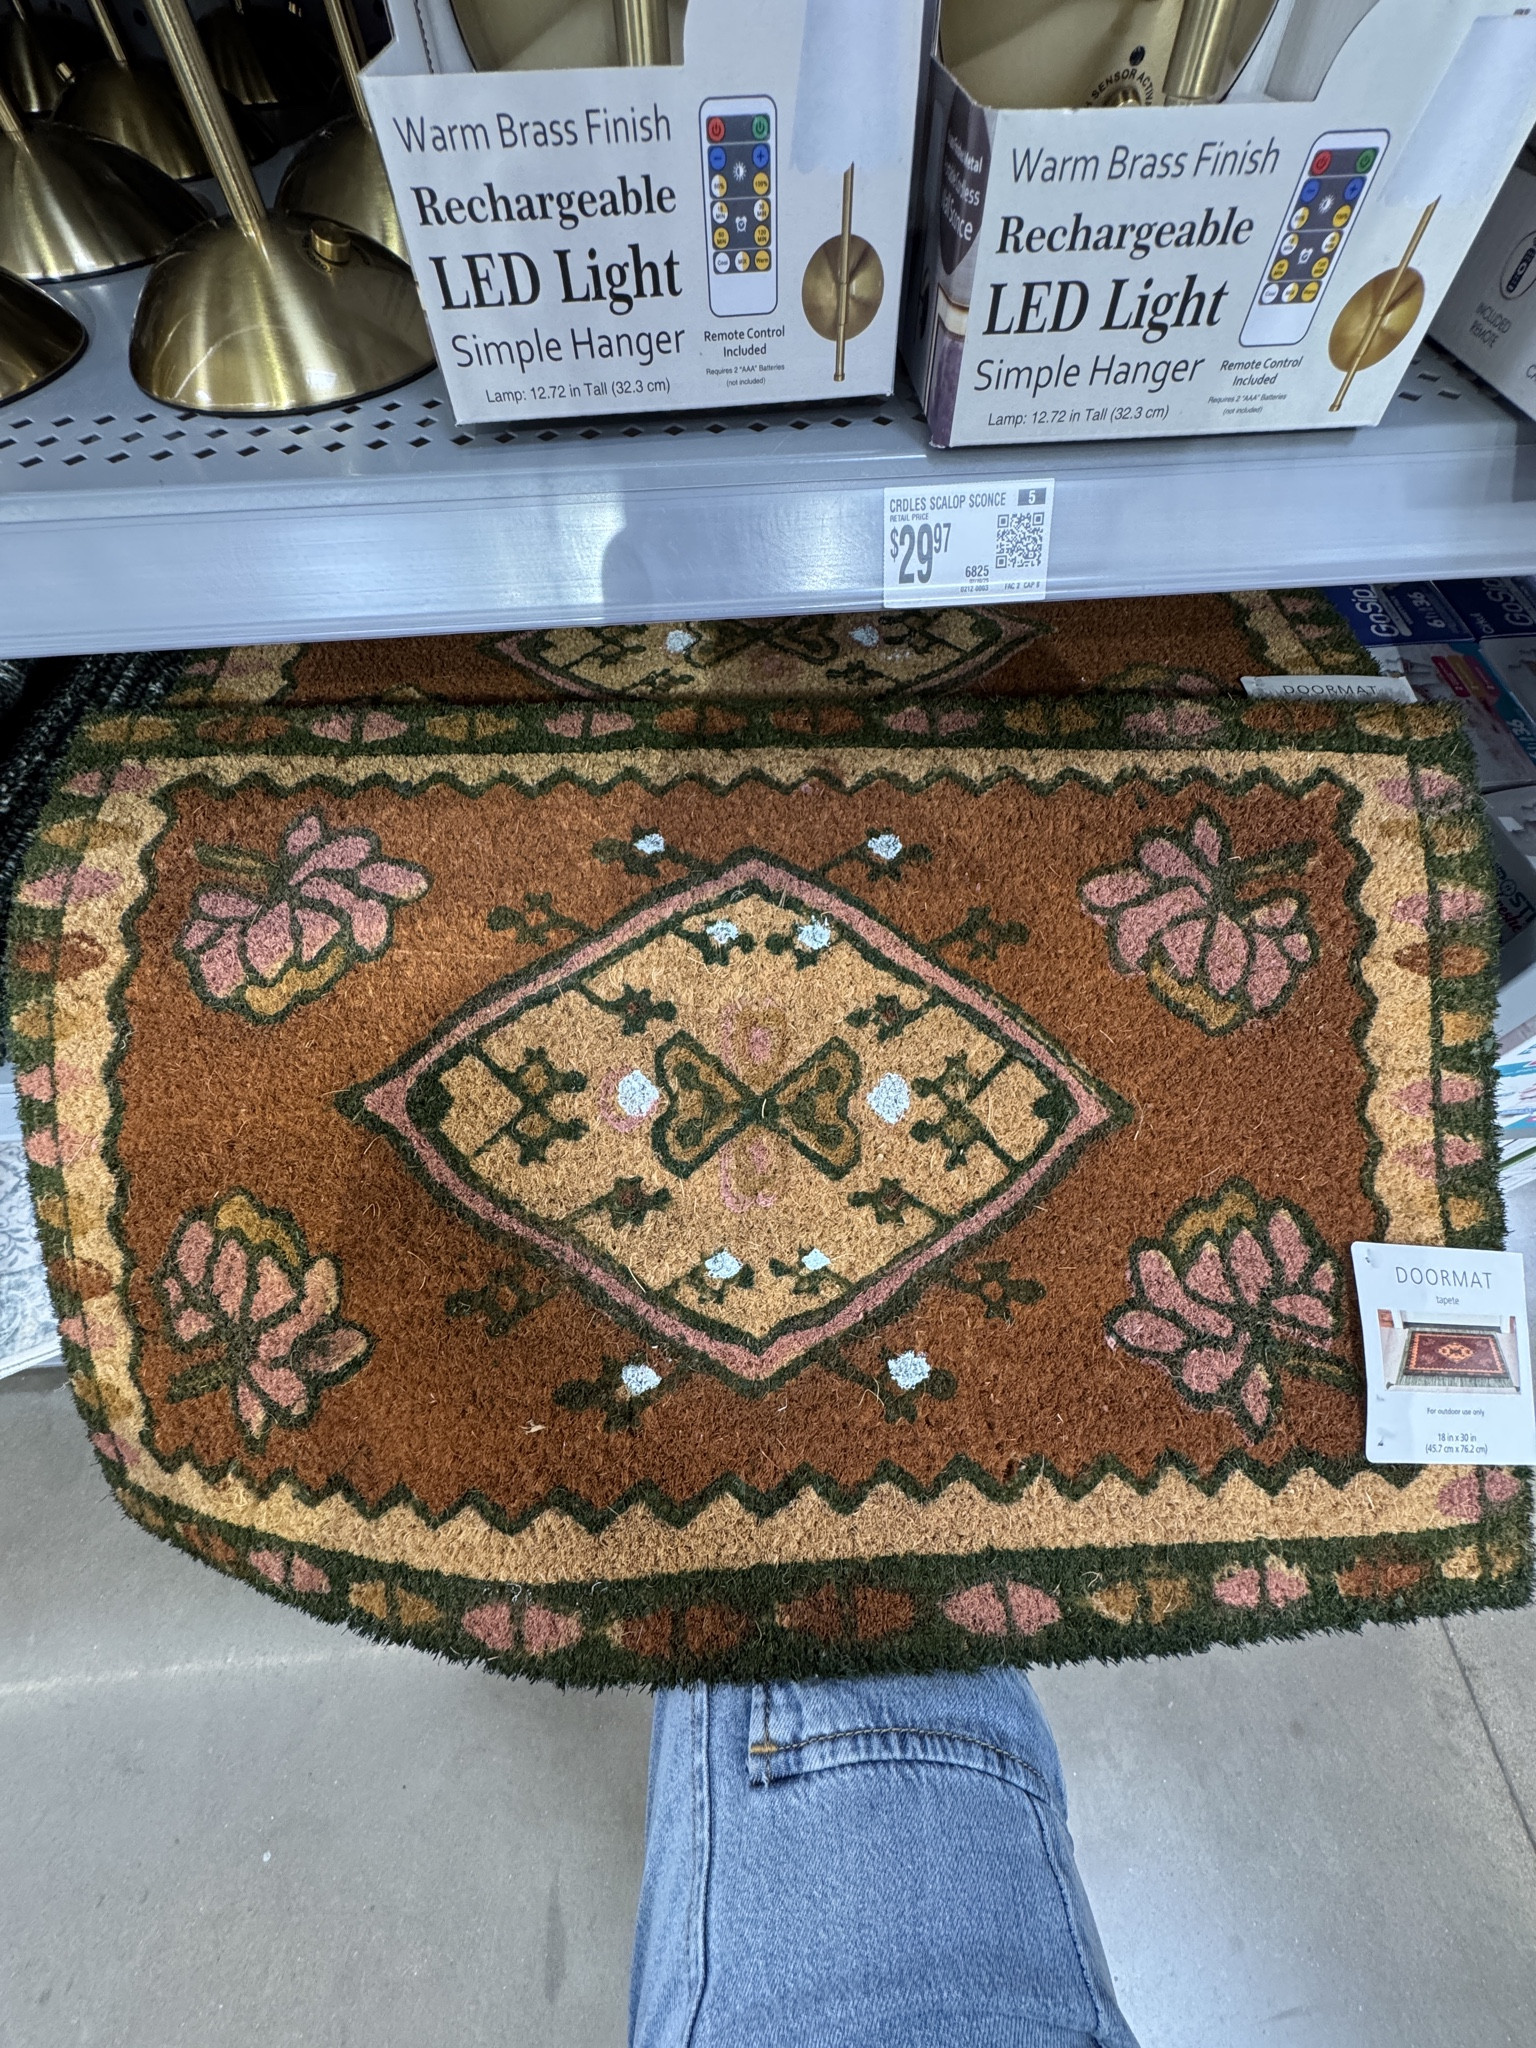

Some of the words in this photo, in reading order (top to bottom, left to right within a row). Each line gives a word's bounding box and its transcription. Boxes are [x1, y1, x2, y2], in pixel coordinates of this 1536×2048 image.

[1091, 68, 1137, 99] SENSOR
[392, 115, 491, 153] Warm
[496, 112, 579, 149] Brass
[585, 102, 671, 145] Finish
[1011, 146, 1100, 183] Warm
[1107, 144, 1189, 181] Brass
[1193, 136, 1281, 178] Finish
[410, 174, 677, 231] Rechargeable
[995, 205, 1254, 261] Rechargeable
[428, 251, 541, 311] LED
[553, 243, 683, 316] Light
[982, 280, 1090, 336] LED
[1099, 273, 1230, 344] Light
[703, 329, 745, 342] Remote
[746, 324, 785, 339] Control
[451, 327, 563, 374] Simple
[570, 326, 686, 367] Hanger
[723, 342, 767, 357] Included
[705, 367, 733, 376] Requires
[733, 366, 739, 374] 2
[758, 364, 785, 372] Batteries
[1219, 359, 1262, 372] Remote
[1263, 355, 1304, 369] Control
[973, 354, 1081, 398] Simple
[1088, 354, 1206, 393] Hanger
[1232, 372, 1278, 386] Included
[485, 389, 527, 404] Lamp:
[531, 385, 566, 400] 12.72
[569, 384, 581, 398] in
[583, 381, 608, 396] Tall
[611, 379, 644, 397] (32.3
[646, 377, 671, 394] cm)
[1207, 396, 1235, 404] Requires
[1235, 395, 1241, 403] 2
[1260, 393, 1288, 401] Batteries
[988, 411, 1027, 428] Lamp:
[1032, 410, 1067, 424] 12.72
[1069, 409, 1081, 422] in
[1085, 407, 1107, 421] Tall
[1110, 406, 1143, 423] (32.3
[1145, 404, 1170, 420] cm)
[889, 497, 927, 513] CRDLES
[929, 494, 966, 511] SCALOP
[968, 492, 1006, 508] SCONCE
[1028, 489, 1036, 504] 5
[889, 514, 910, 523] RETAIL
[911, 513, 929, 521] PRICE
[965, 565, 990, 578] 6825
[1282, 684, 1377, 697] DOORMAT
[1395, 1266, 1492, 1289] DOORMAT
[1436, 1295, 1460, 1306] tapete
[1426, 1407, 1436, 1415] For
[1473, 1408, 1485, 1417] only
[1438, 1432, 1446, 1442] 18
[1447, 1432, 1454, 1442] in
[1460, 1432, 1469, 1442] 30
[1470, 1432, 1477, 1442] in
[1425, 1443, 1443, 1454] (45.7
[1460, 1444, 1475, 1454] 76.2
[1475, 1443, 1488, 1455] cm)
